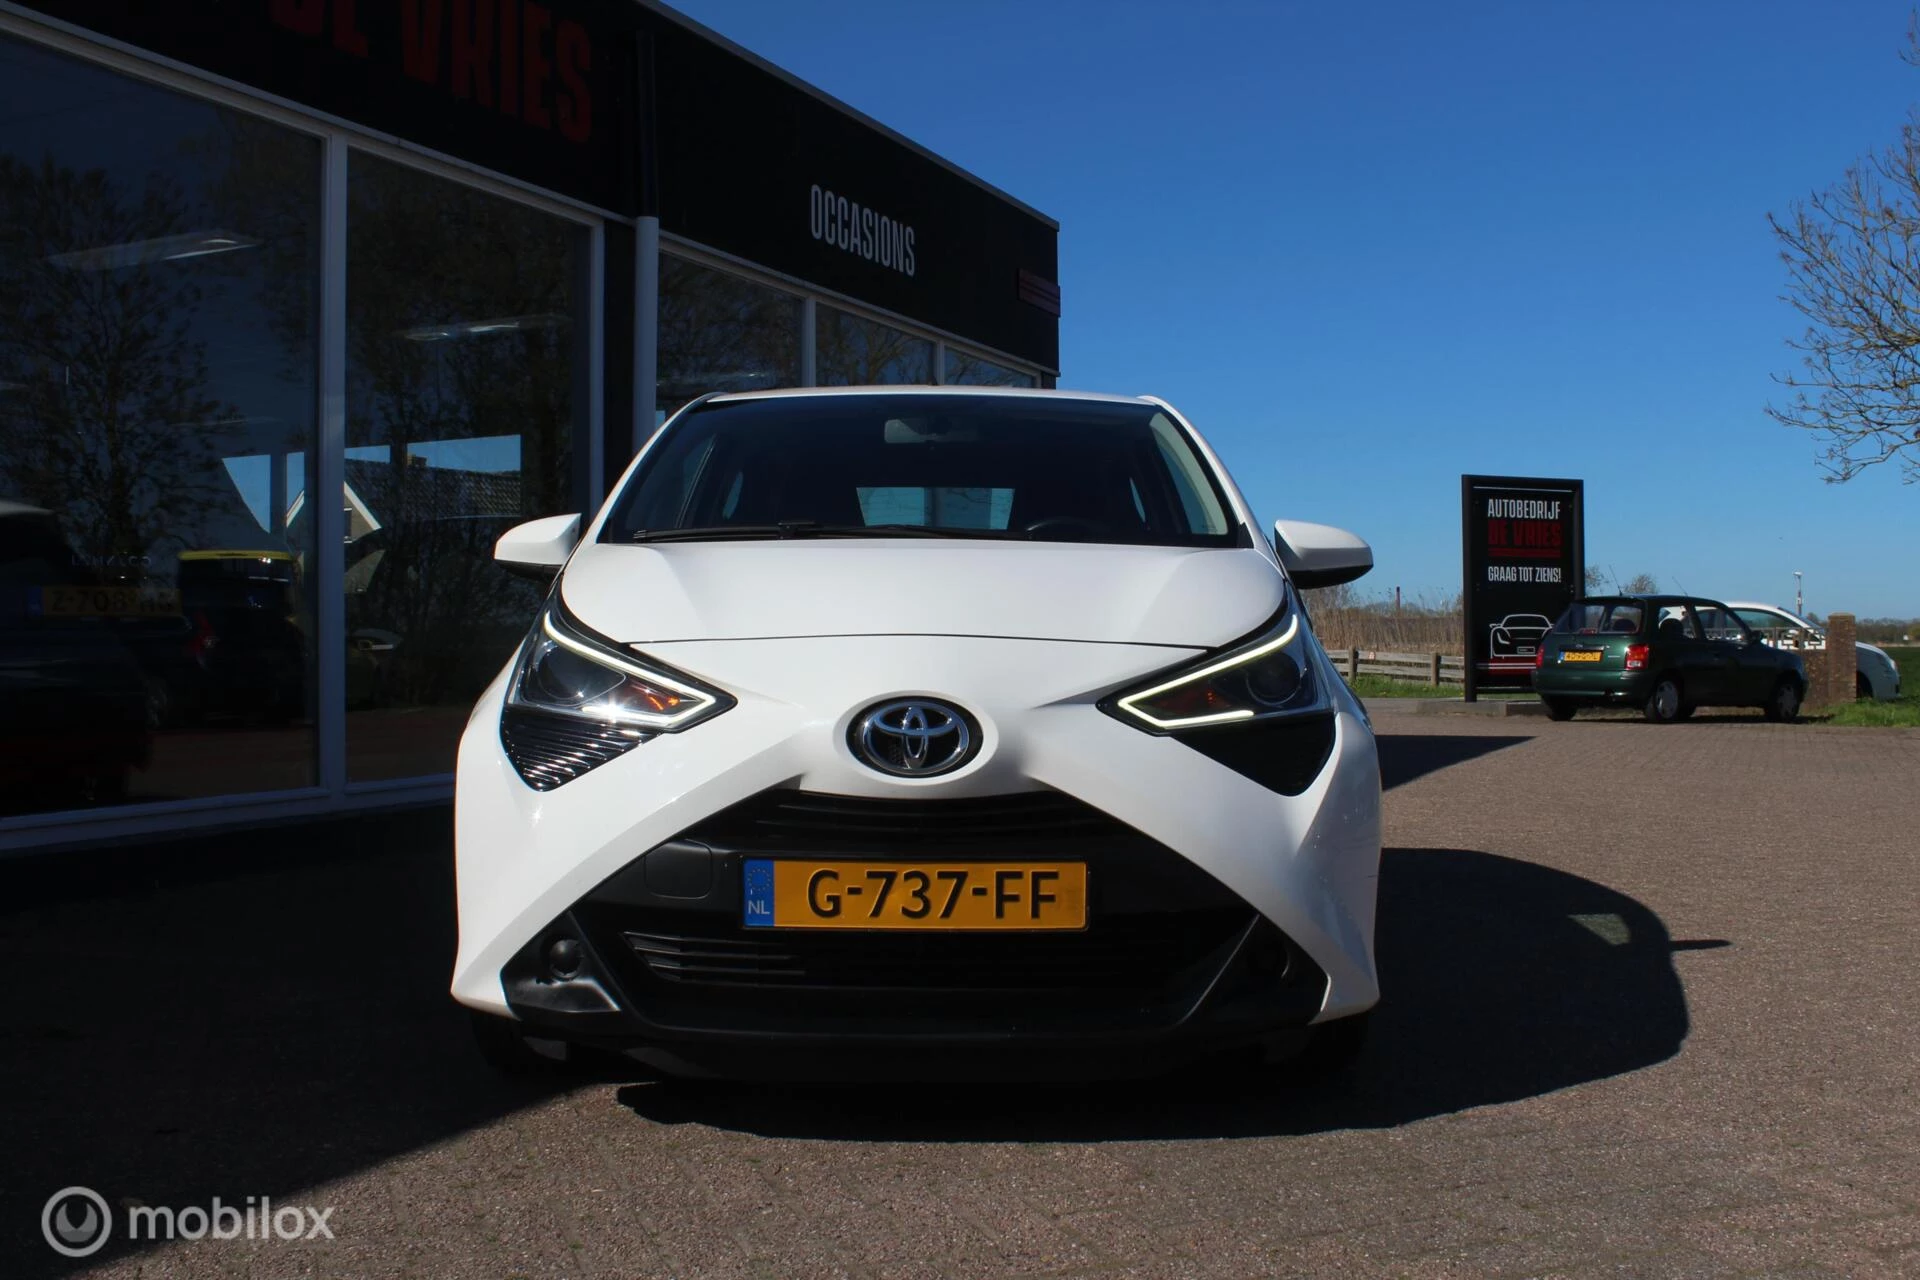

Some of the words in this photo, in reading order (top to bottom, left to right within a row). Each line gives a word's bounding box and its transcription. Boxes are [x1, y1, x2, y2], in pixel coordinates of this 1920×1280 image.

[810, 183, 916, 278] OCCASIONS
[1487, 498, 1561, 520] AUTOBEDRIJF
[1487, 565, 1518, 582] GRAAG
[1518, 565, 1534, 582] TOT
[1535, 566, 1562, 583] ZIENS!
[747, 899, 770, 915] NL
[807, 868, 1060, 920] G-737-FF
